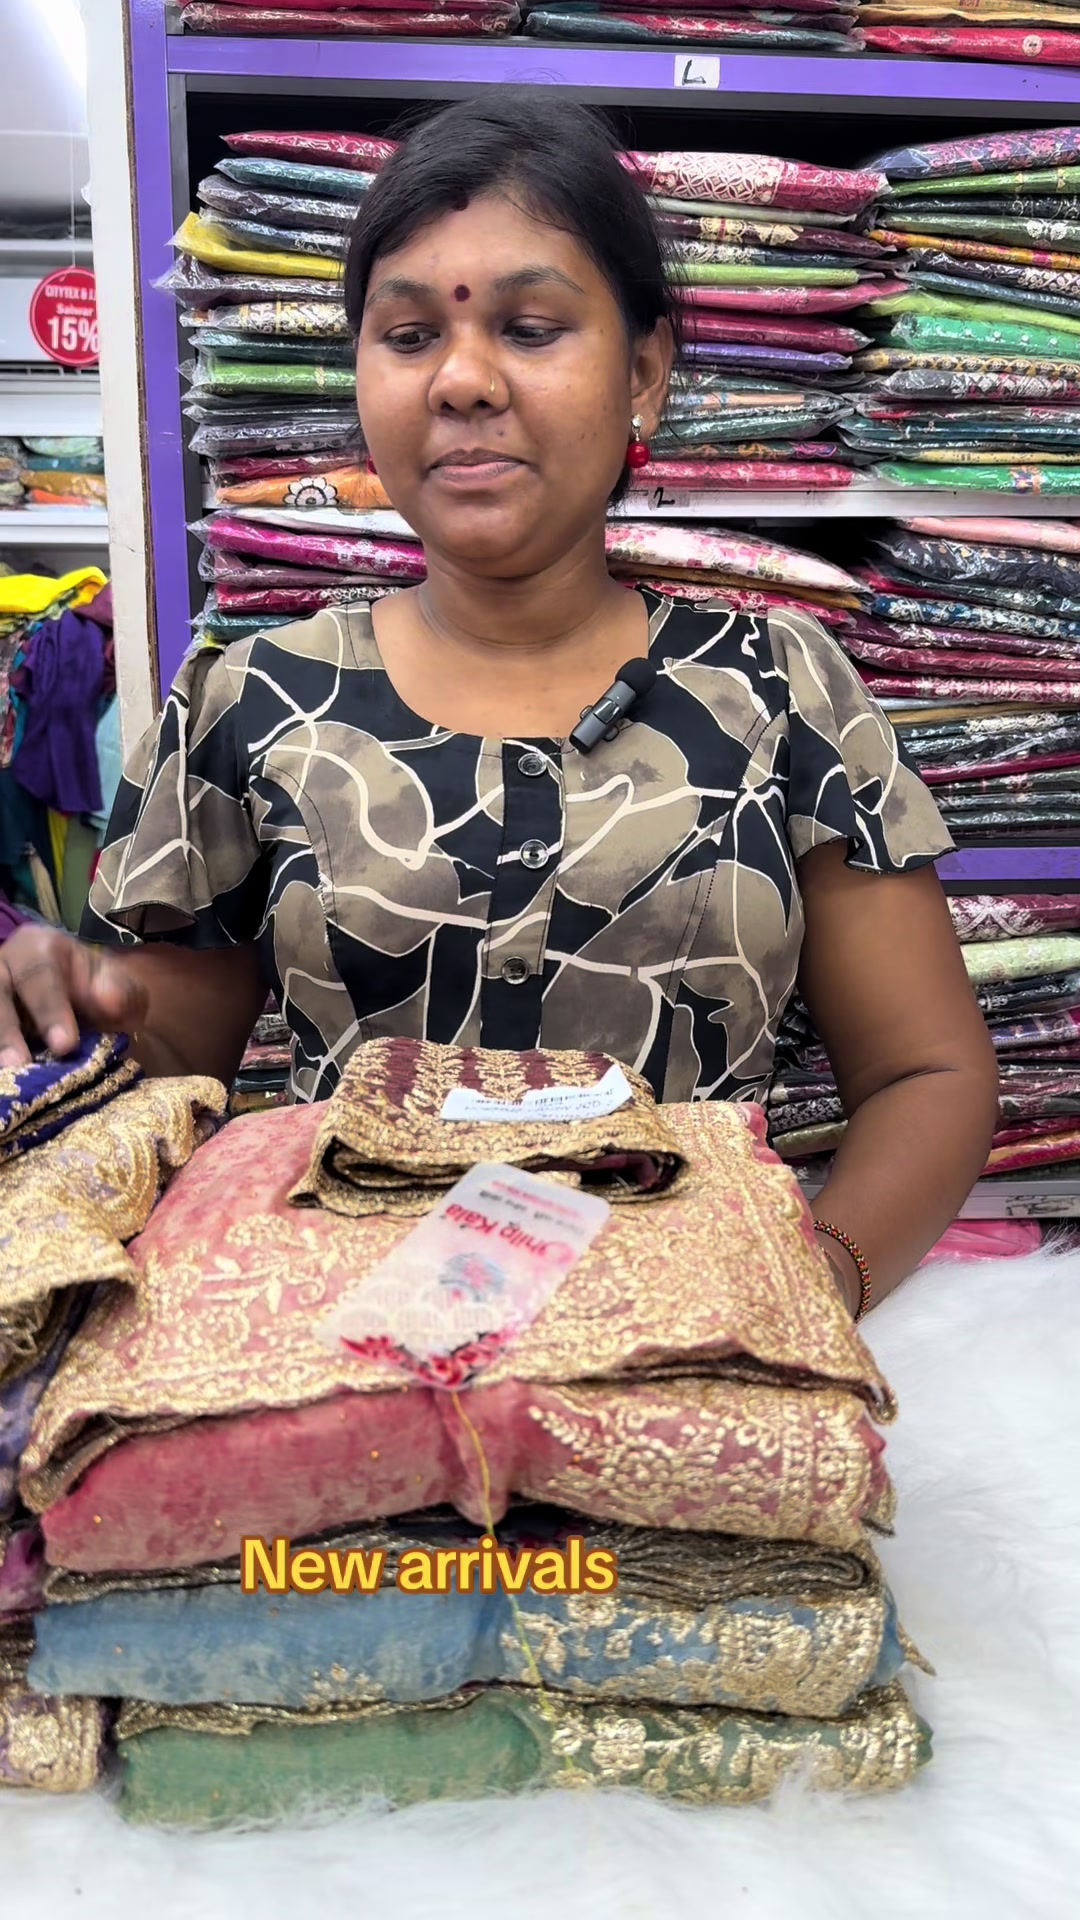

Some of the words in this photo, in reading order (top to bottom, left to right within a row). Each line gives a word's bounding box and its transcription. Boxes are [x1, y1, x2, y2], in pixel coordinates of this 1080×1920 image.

[56, 302, 94, 317] Salwar
[47, 316, 99, 353] 15%
[445, 1203, 499, 1235] Kala
